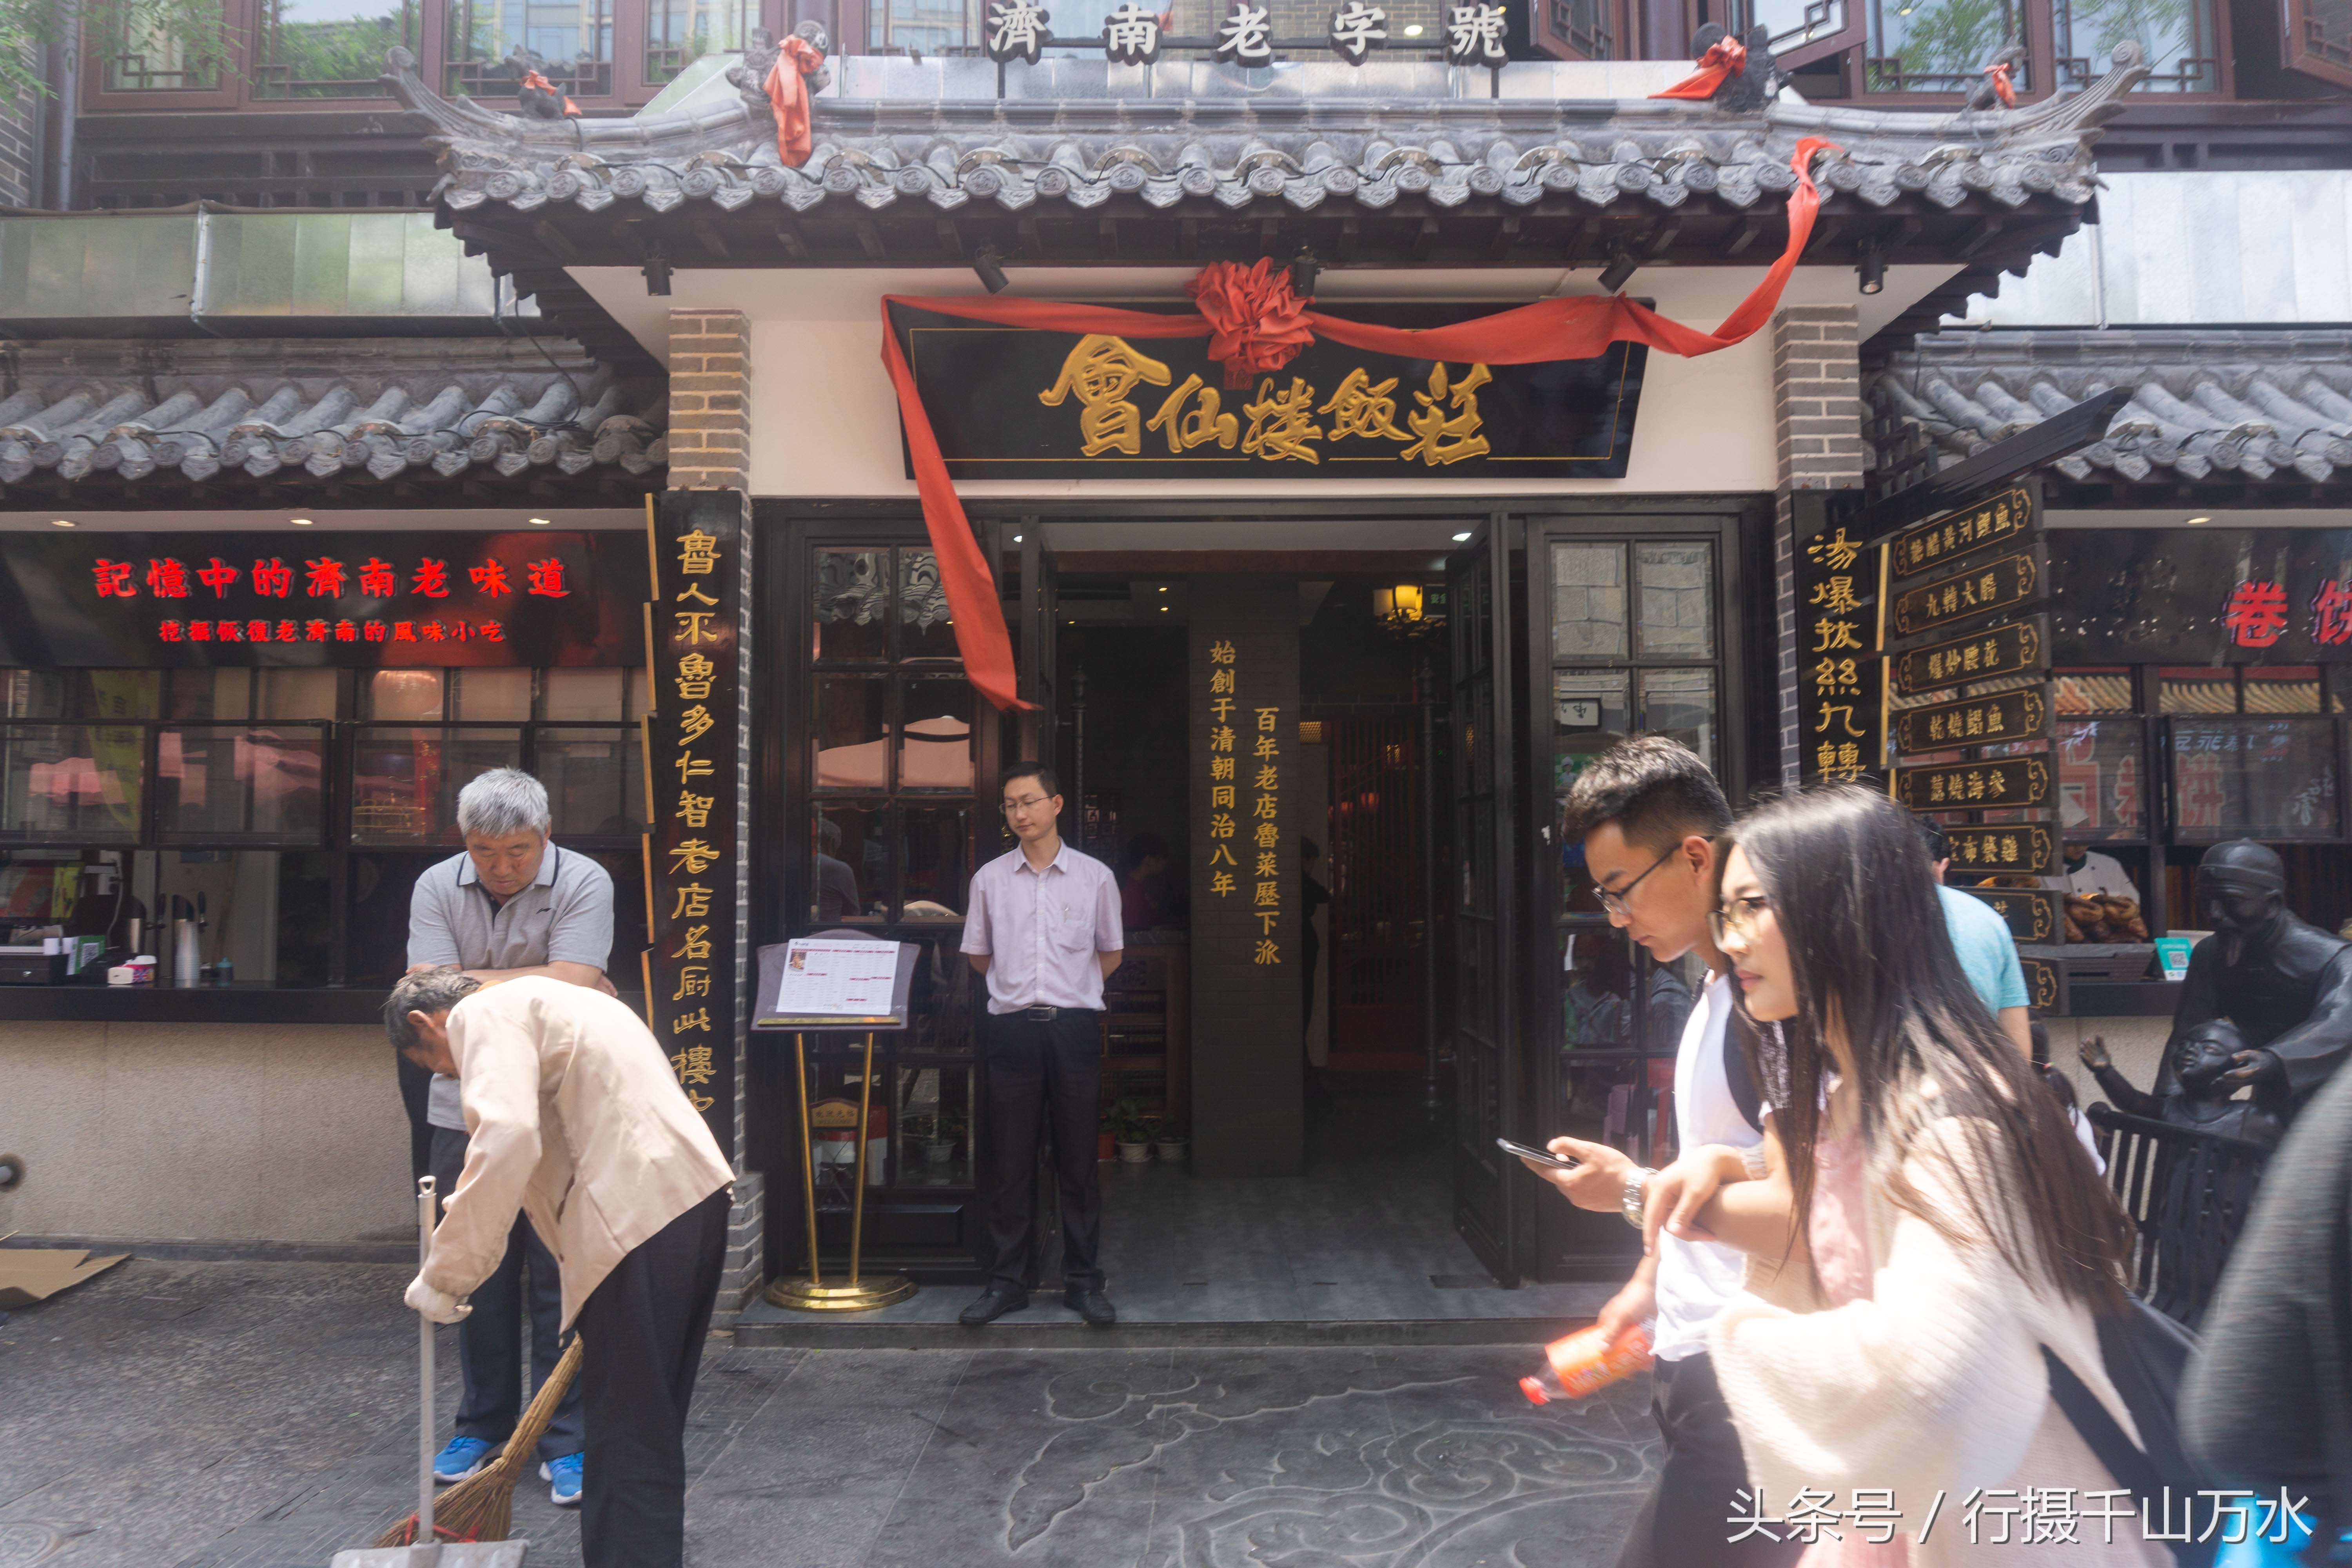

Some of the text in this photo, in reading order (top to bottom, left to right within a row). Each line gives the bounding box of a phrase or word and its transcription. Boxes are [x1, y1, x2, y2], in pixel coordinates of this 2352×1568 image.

[987, 0, 1506, 58] 濟南老字號
[91, 557, 572, 599] 記憶中的濟南老味道
[1209, 640, 1238, 897] 始創于清朝同治八年
